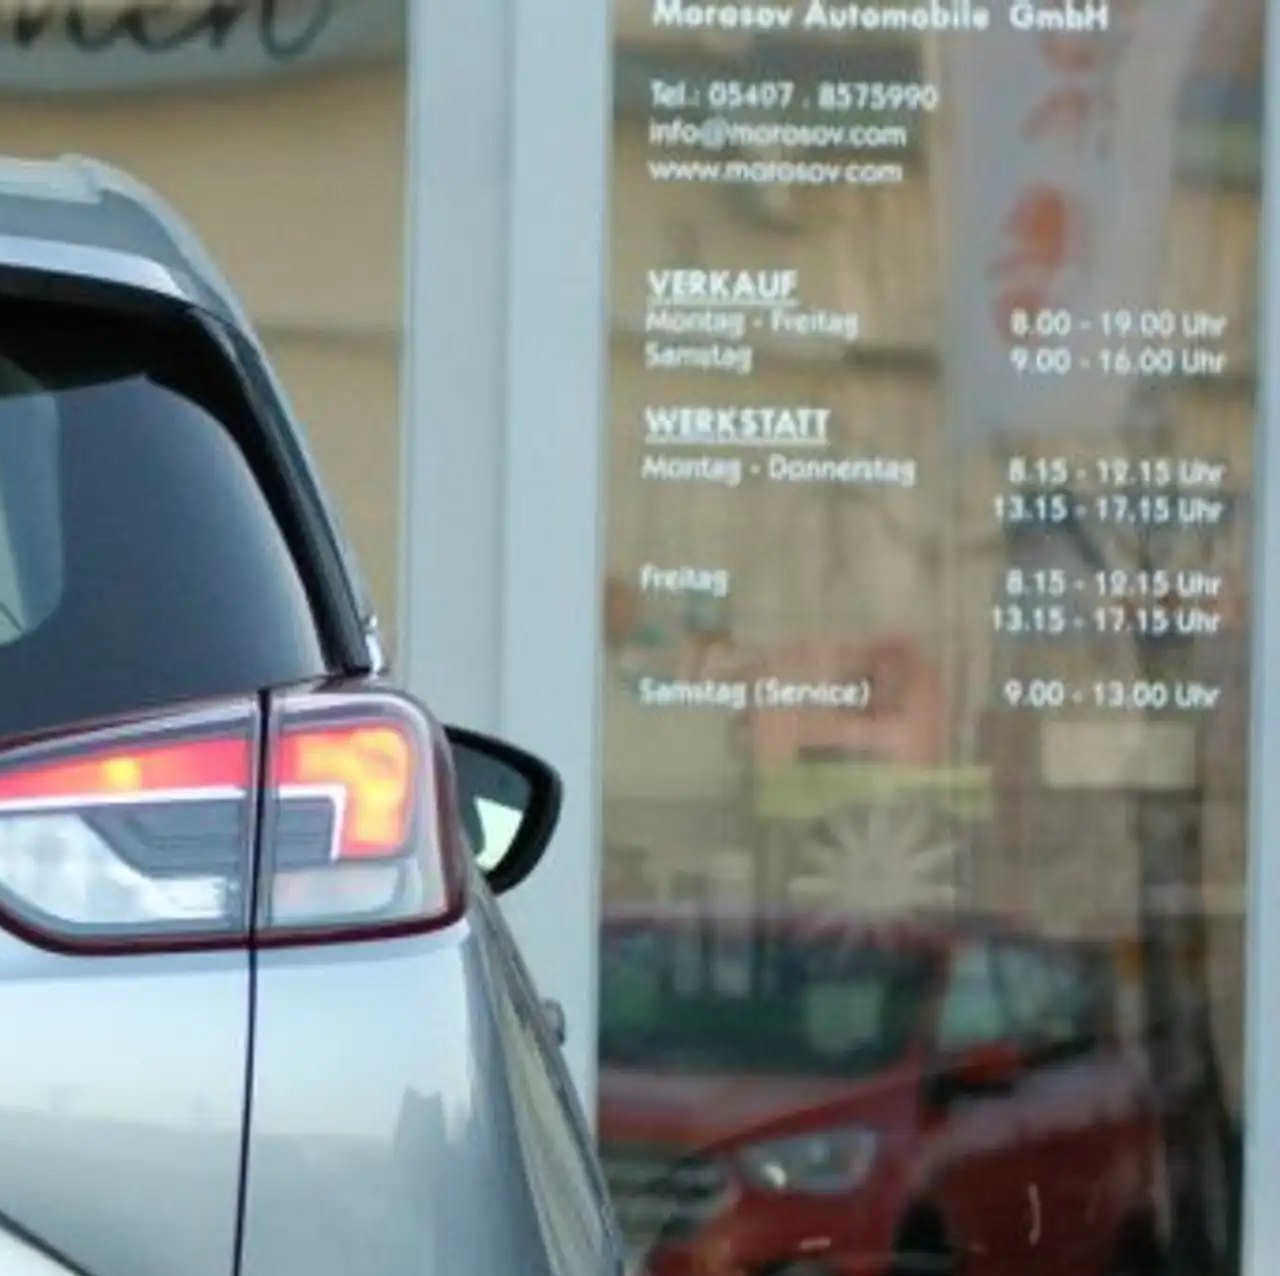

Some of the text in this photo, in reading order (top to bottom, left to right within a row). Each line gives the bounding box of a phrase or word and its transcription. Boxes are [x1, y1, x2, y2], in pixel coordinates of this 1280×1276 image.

[651, 0, 1110, 31] Morosov Automobile GmbH
[708, 80, 795, 110] 05407
[816, 81, 940, 114] 8575990
[648, 117, 908, 150] info@morosov.com
[646, 159, 905, 185] www.morosov.com
[648, 268, 799, 303] VERKAUF
[645, 309, 747, 341] Montag
[770, 305, 860, 342] Freitag
[1009, 307, 1073, 338] 8.00
[1100, 308, 1177, 339] 19.00
[1180, 309, 1229, 337] Uhr
[644, 340, 755, 376] Samstag
[1008, 345, 1073, 379] 9.00
[1098, 345, 1175, 377] 16.00
[1180, 346, 1229, 376] Uhr
[644, 406, 832, 441] WERKSTATT
[641, 453, 743, 488] Montag
[768, 452, 917, 490] Donnerstag
[1007, 455, 1070, 486] 8.15
[1178, 457, 1227, 488] Uhr
[993, 493, 1070, 523] 13.15
[1094, 494, 1171, 525] 17.15
[1177, 495, 1225, 524] Uhr
[640, 562, 731, 598] Freitag
[1004, 567, 1068, 598] 8.15
[1175, 569, 1223, 598] Uhr
[991, 603, 1067, 635] 13.15
[1093, 604, 1170, 636] 17.15
[1174, 606, 1223, 636] Uhr
[639, 676, 871, 713] Samstag (Service)
[1003, 677, 1066, 708] 9.00
[1091, 679, 1170, 709] 13.00
[1172, 680, 1223, 709] Uhr
